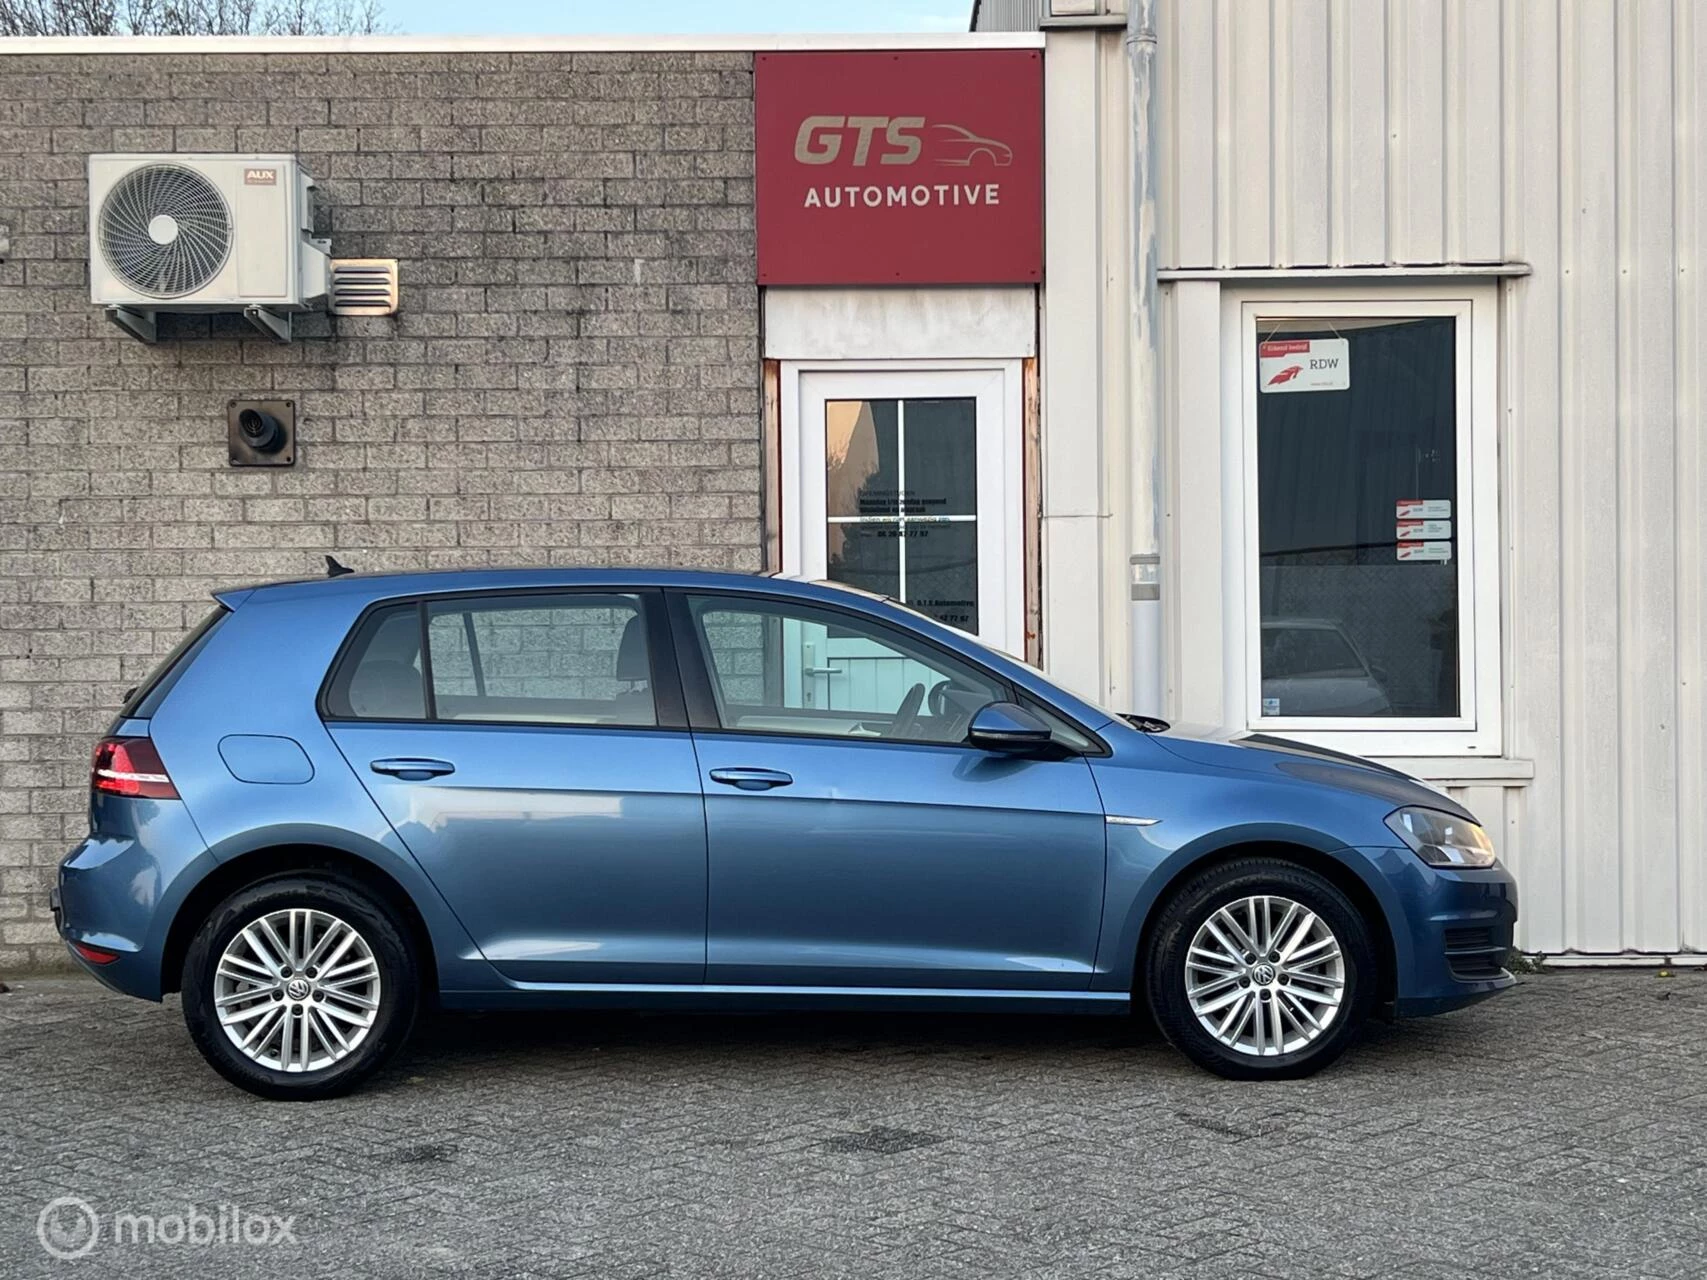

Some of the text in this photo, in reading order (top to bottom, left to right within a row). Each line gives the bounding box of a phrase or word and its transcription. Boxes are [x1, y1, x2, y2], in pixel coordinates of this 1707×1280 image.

[793, 115, 926, 166] GTS
[247, 170, 274, 179] AUX
[804, 183, 1000, 208] AUTOMOTIVE
[1309, 358, 1339, 370] RDW
